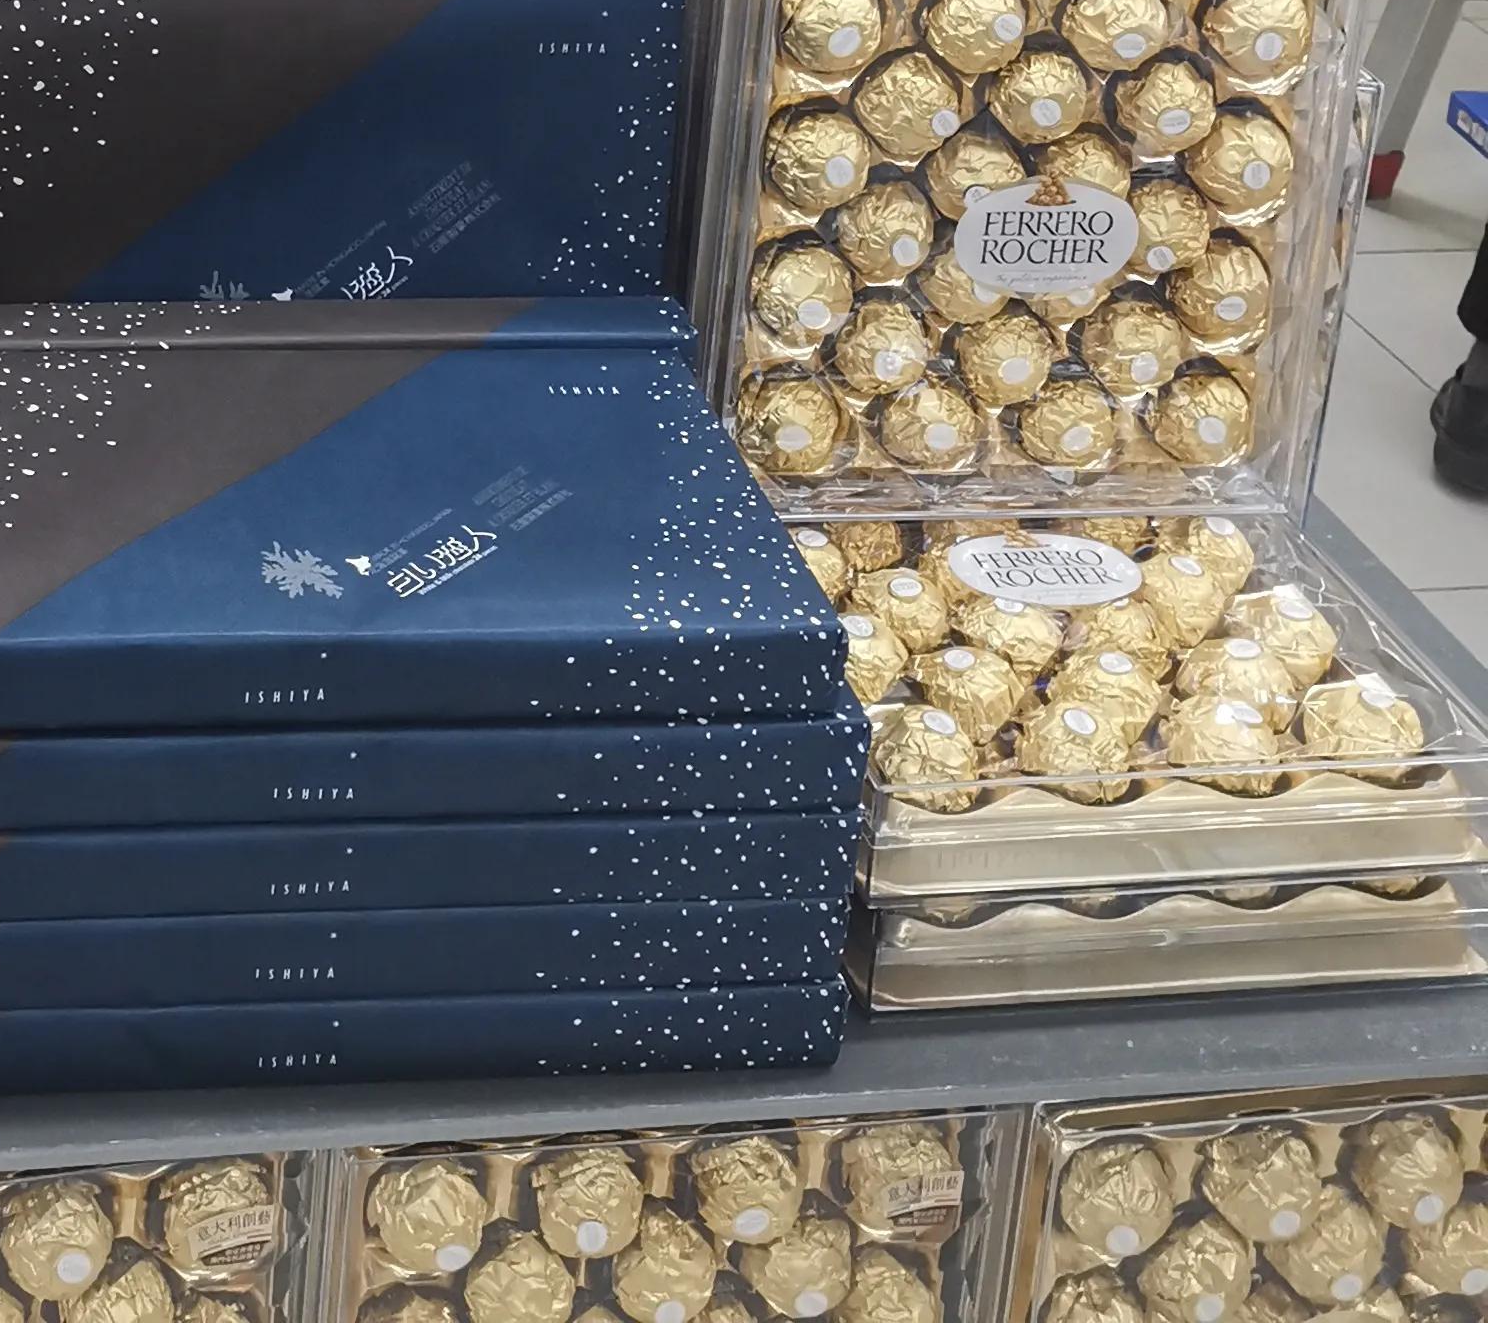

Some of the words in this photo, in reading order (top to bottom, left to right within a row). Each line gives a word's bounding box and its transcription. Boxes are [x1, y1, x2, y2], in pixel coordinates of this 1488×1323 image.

[539, 42, 607, 55] ISHIYA
[983, 210, 1114, 236] FERRERO
[980, 238, 1109, 264] ROCHER
[549, 385, 620, 396] ISHIYA
[971, 548, 1103, 568] FERRERO
[985, 566, 1123, 588] ROCHER
[245, 688, 325, 703] ISHIYA
[273, 787, 354, 800] ISHIYA
[271, 880, 350, 895] ISHIYA
[255, 967, 335, 980] ISHIYA
[258, 1054, 337, 1068] ISHIYA
